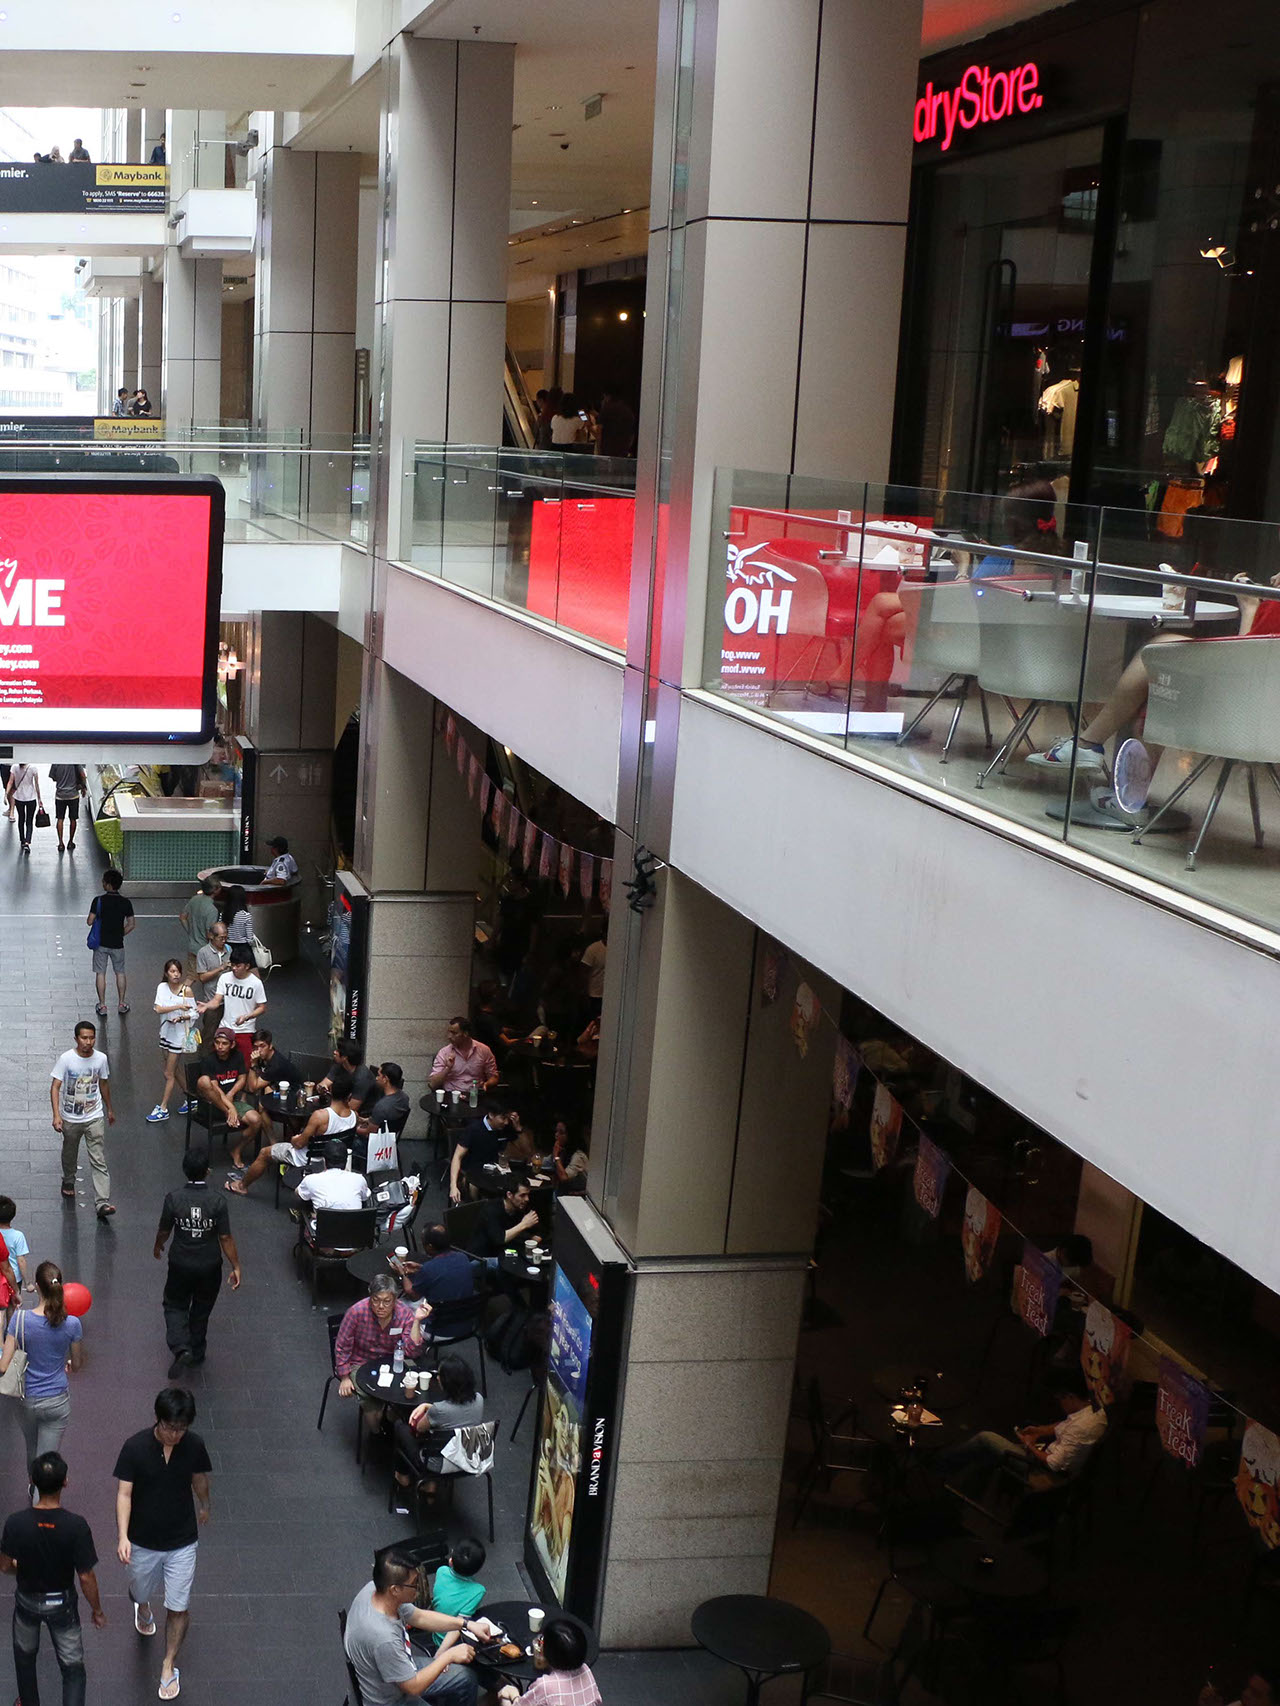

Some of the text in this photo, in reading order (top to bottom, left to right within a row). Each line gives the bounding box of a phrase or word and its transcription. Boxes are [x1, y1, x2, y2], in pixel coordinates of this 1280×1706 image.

[114, 171, 161, 181] Maybank
[112, 425, 159, 435] Maybank
[225, 982, 254, 1000] YOLO
[1160, 1387, 1192, 1441] Freak
[588, 1417, 606, 1497] BRANDaVISION
[1168, 1420, 1198, 1467] Feast
